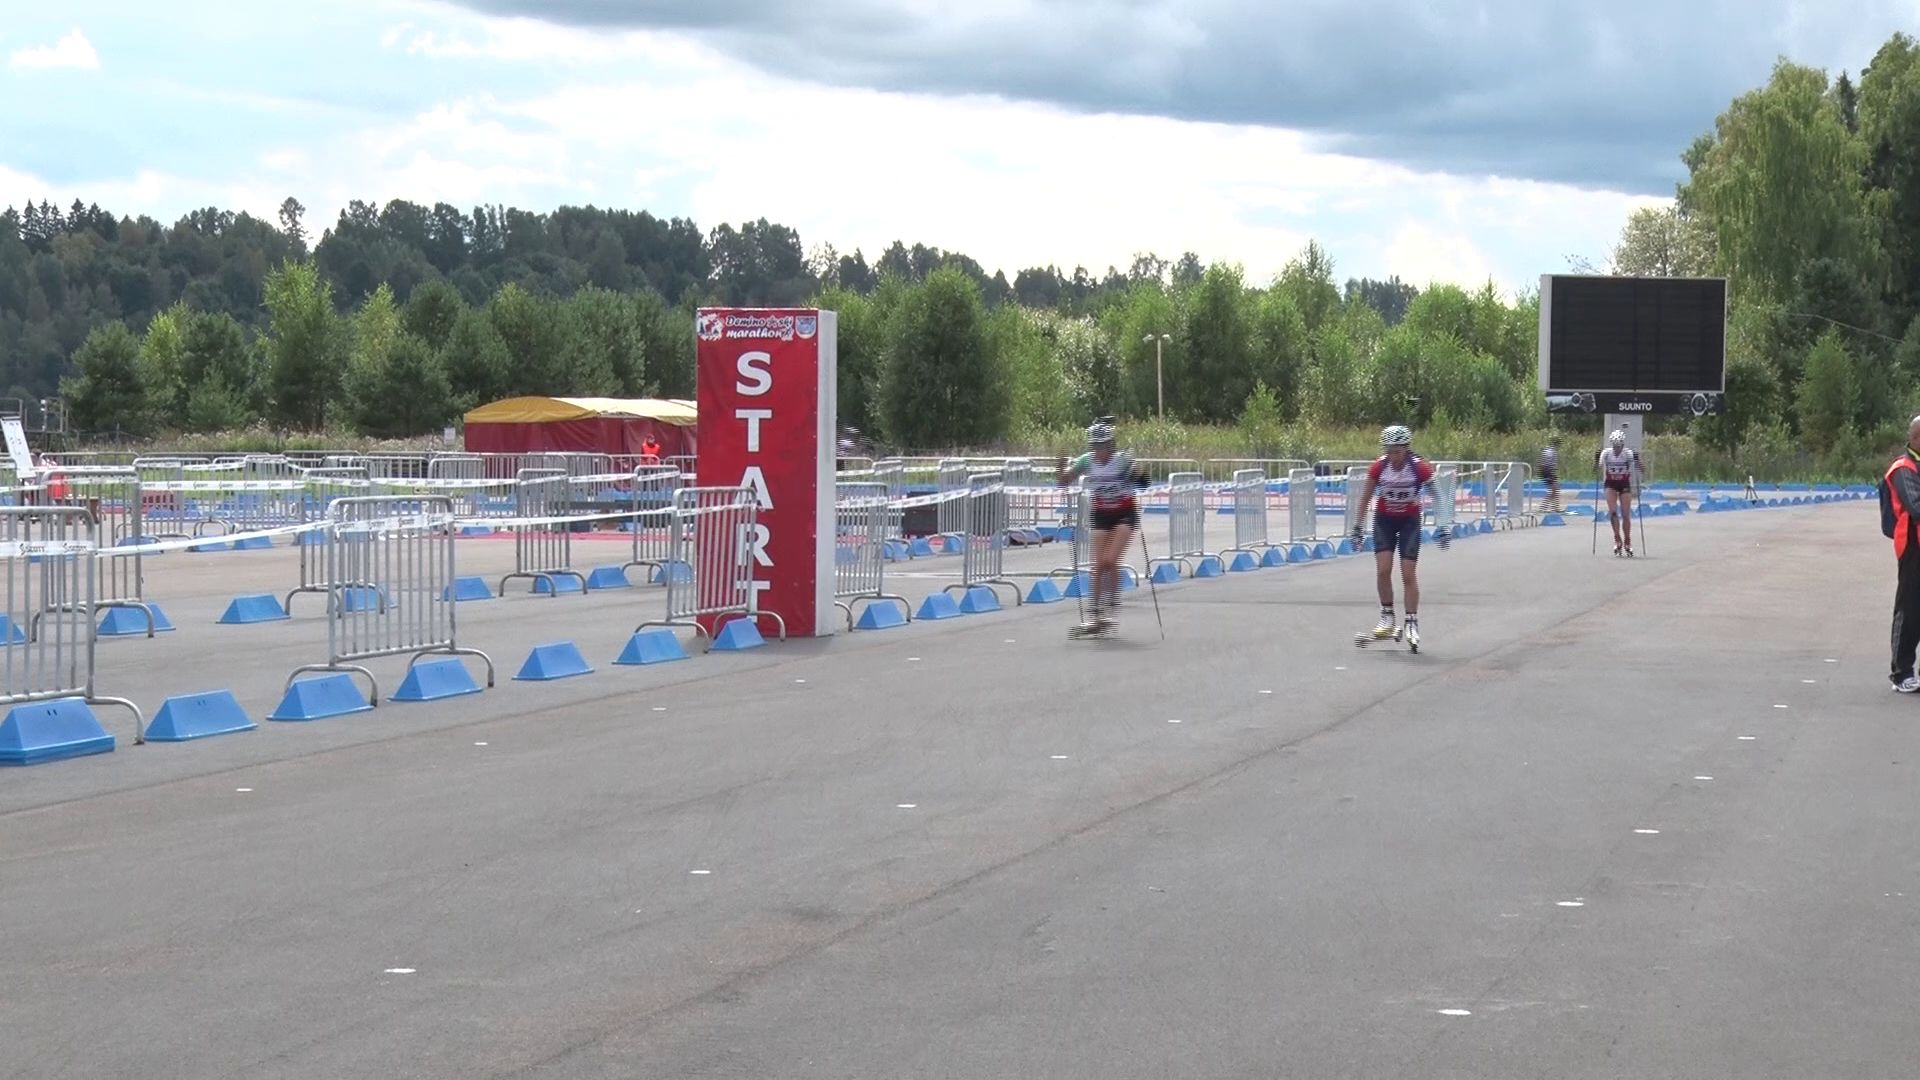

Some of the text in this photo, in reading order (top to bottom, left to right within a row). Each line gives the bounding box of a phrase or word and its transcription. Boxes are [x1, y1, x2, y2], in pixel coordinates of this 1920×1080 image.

[726, 327, 783, 338] marathon
[1618, 402, 1653, 411] SUUNTO
[735, 351, 775, 623] START
